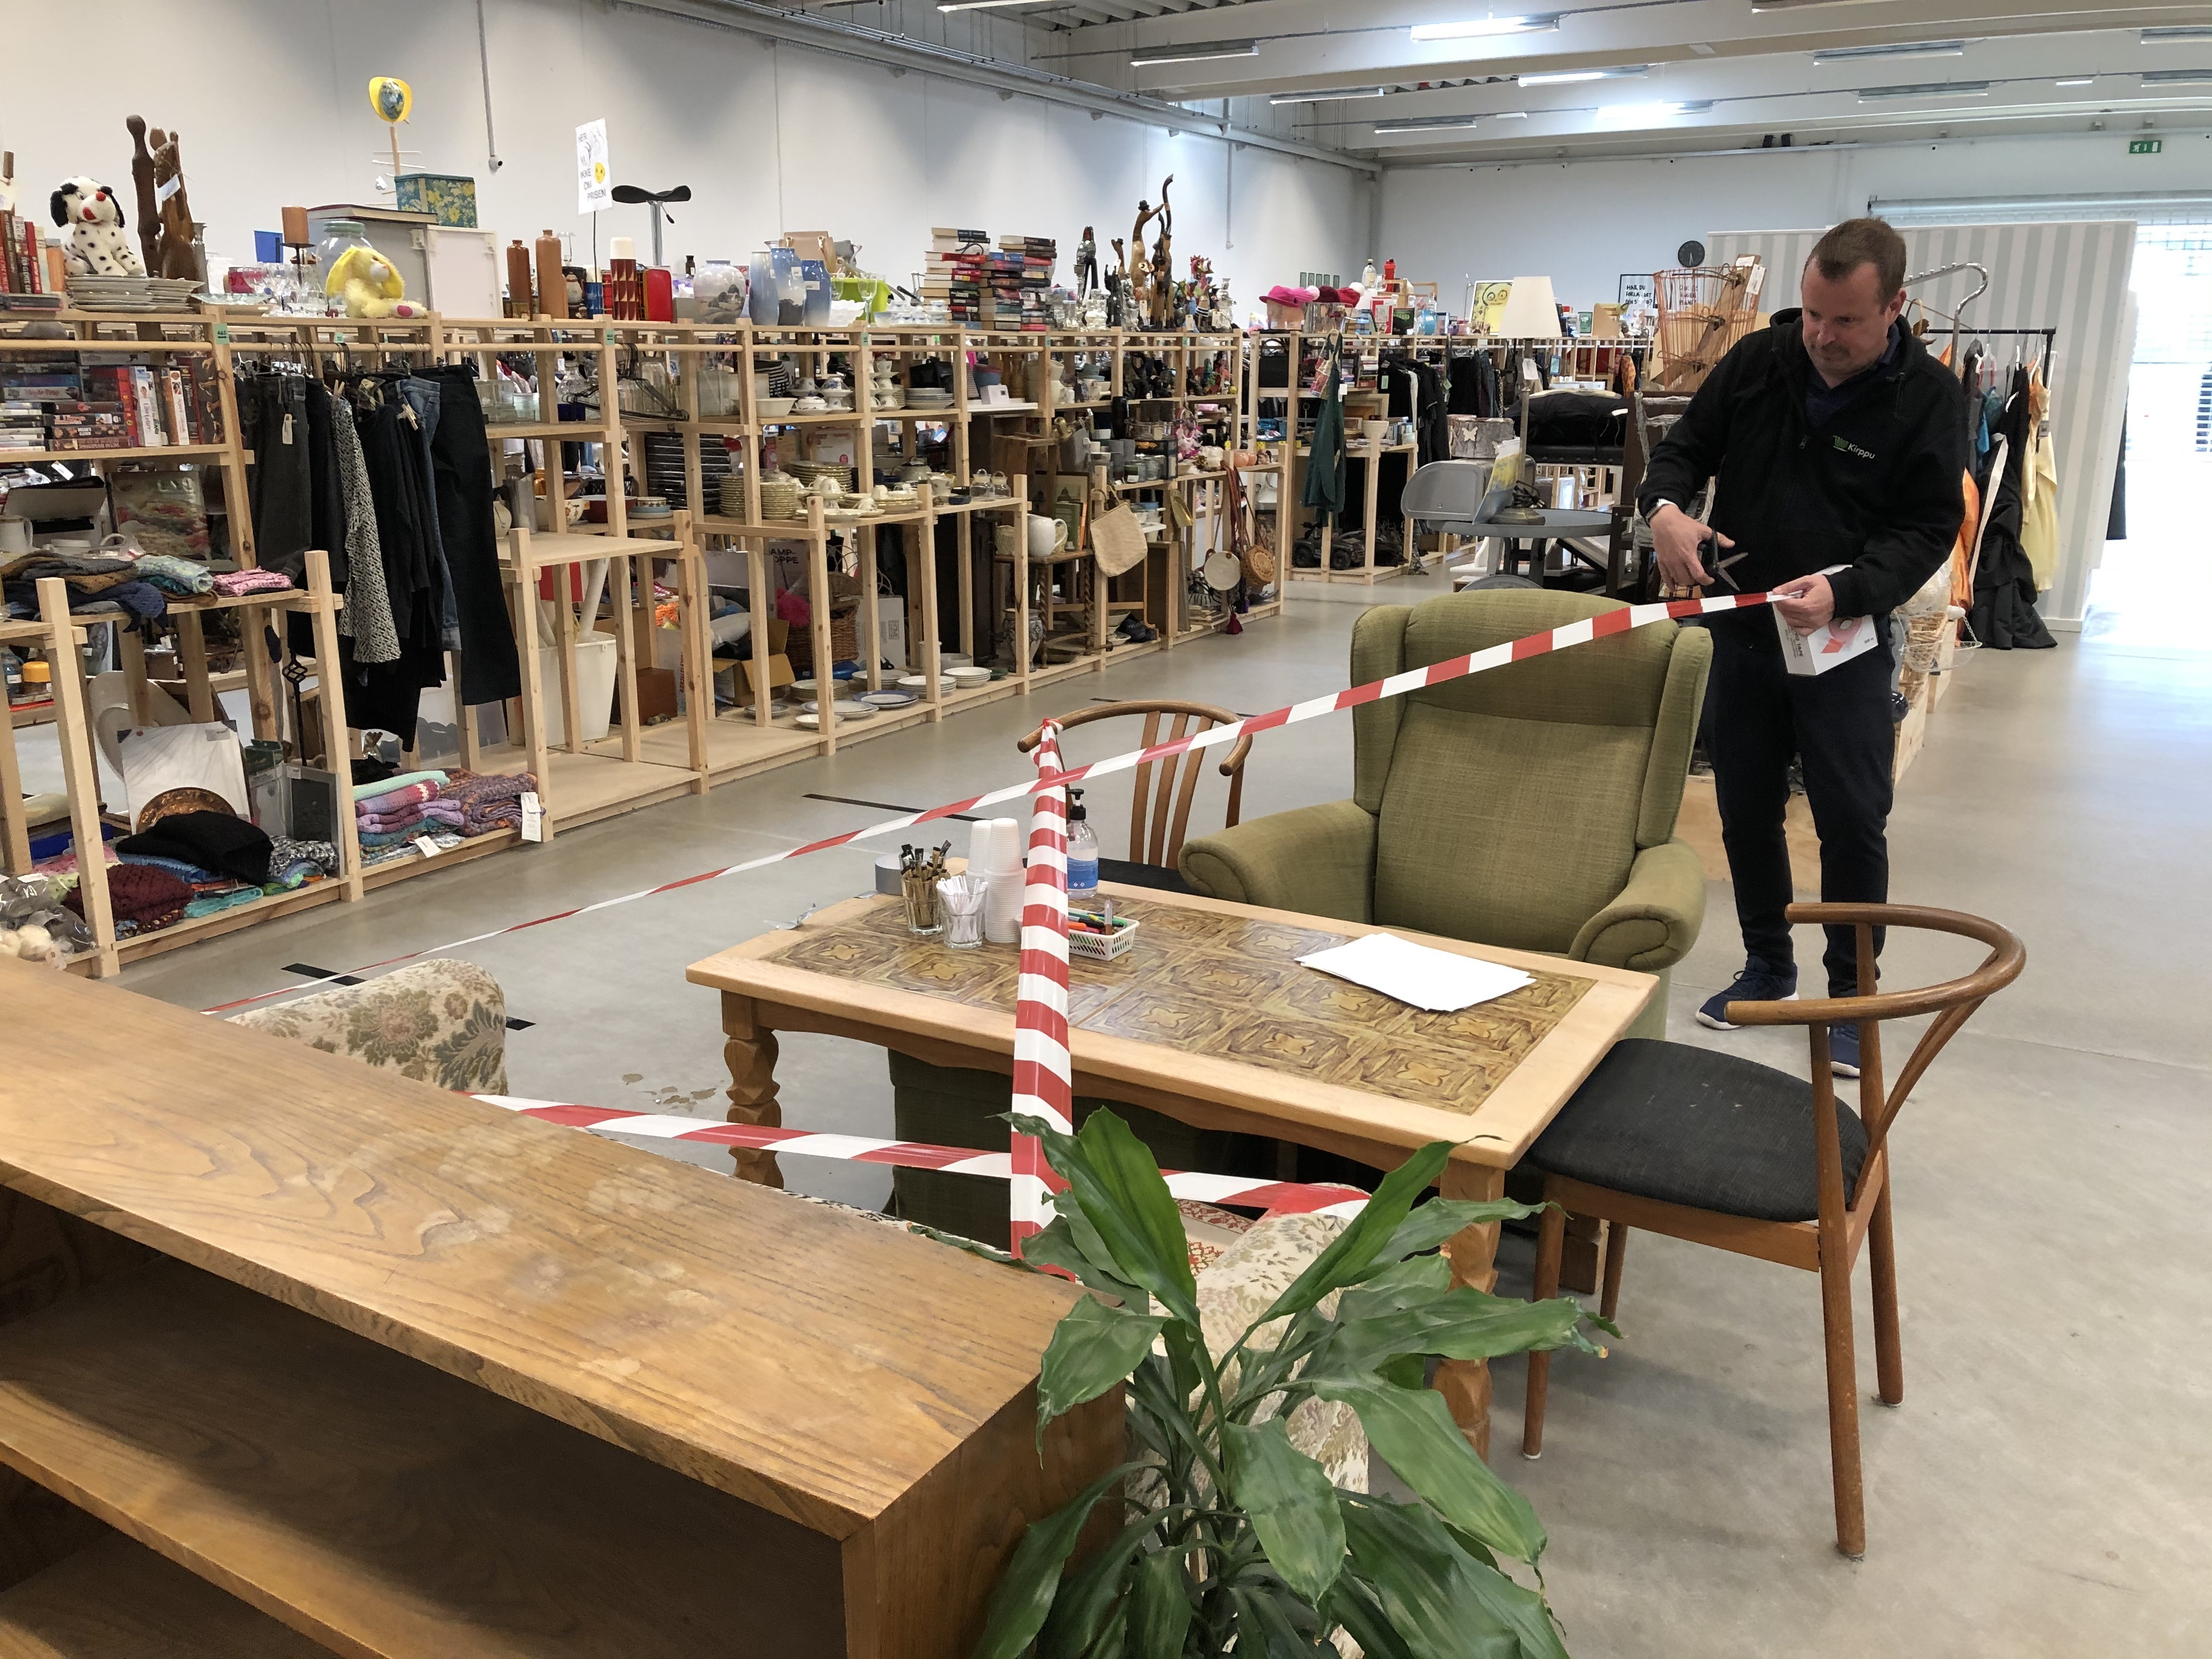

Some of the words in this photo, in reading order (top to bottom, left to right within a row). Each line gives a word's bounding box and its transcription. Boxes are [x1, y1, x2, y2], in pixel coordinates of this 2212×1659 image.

[580, 168, 591, 179] IKKE
[587, 188, 607, 201] PRISEN
[1848, 443, 1876, 459] Kirppu
